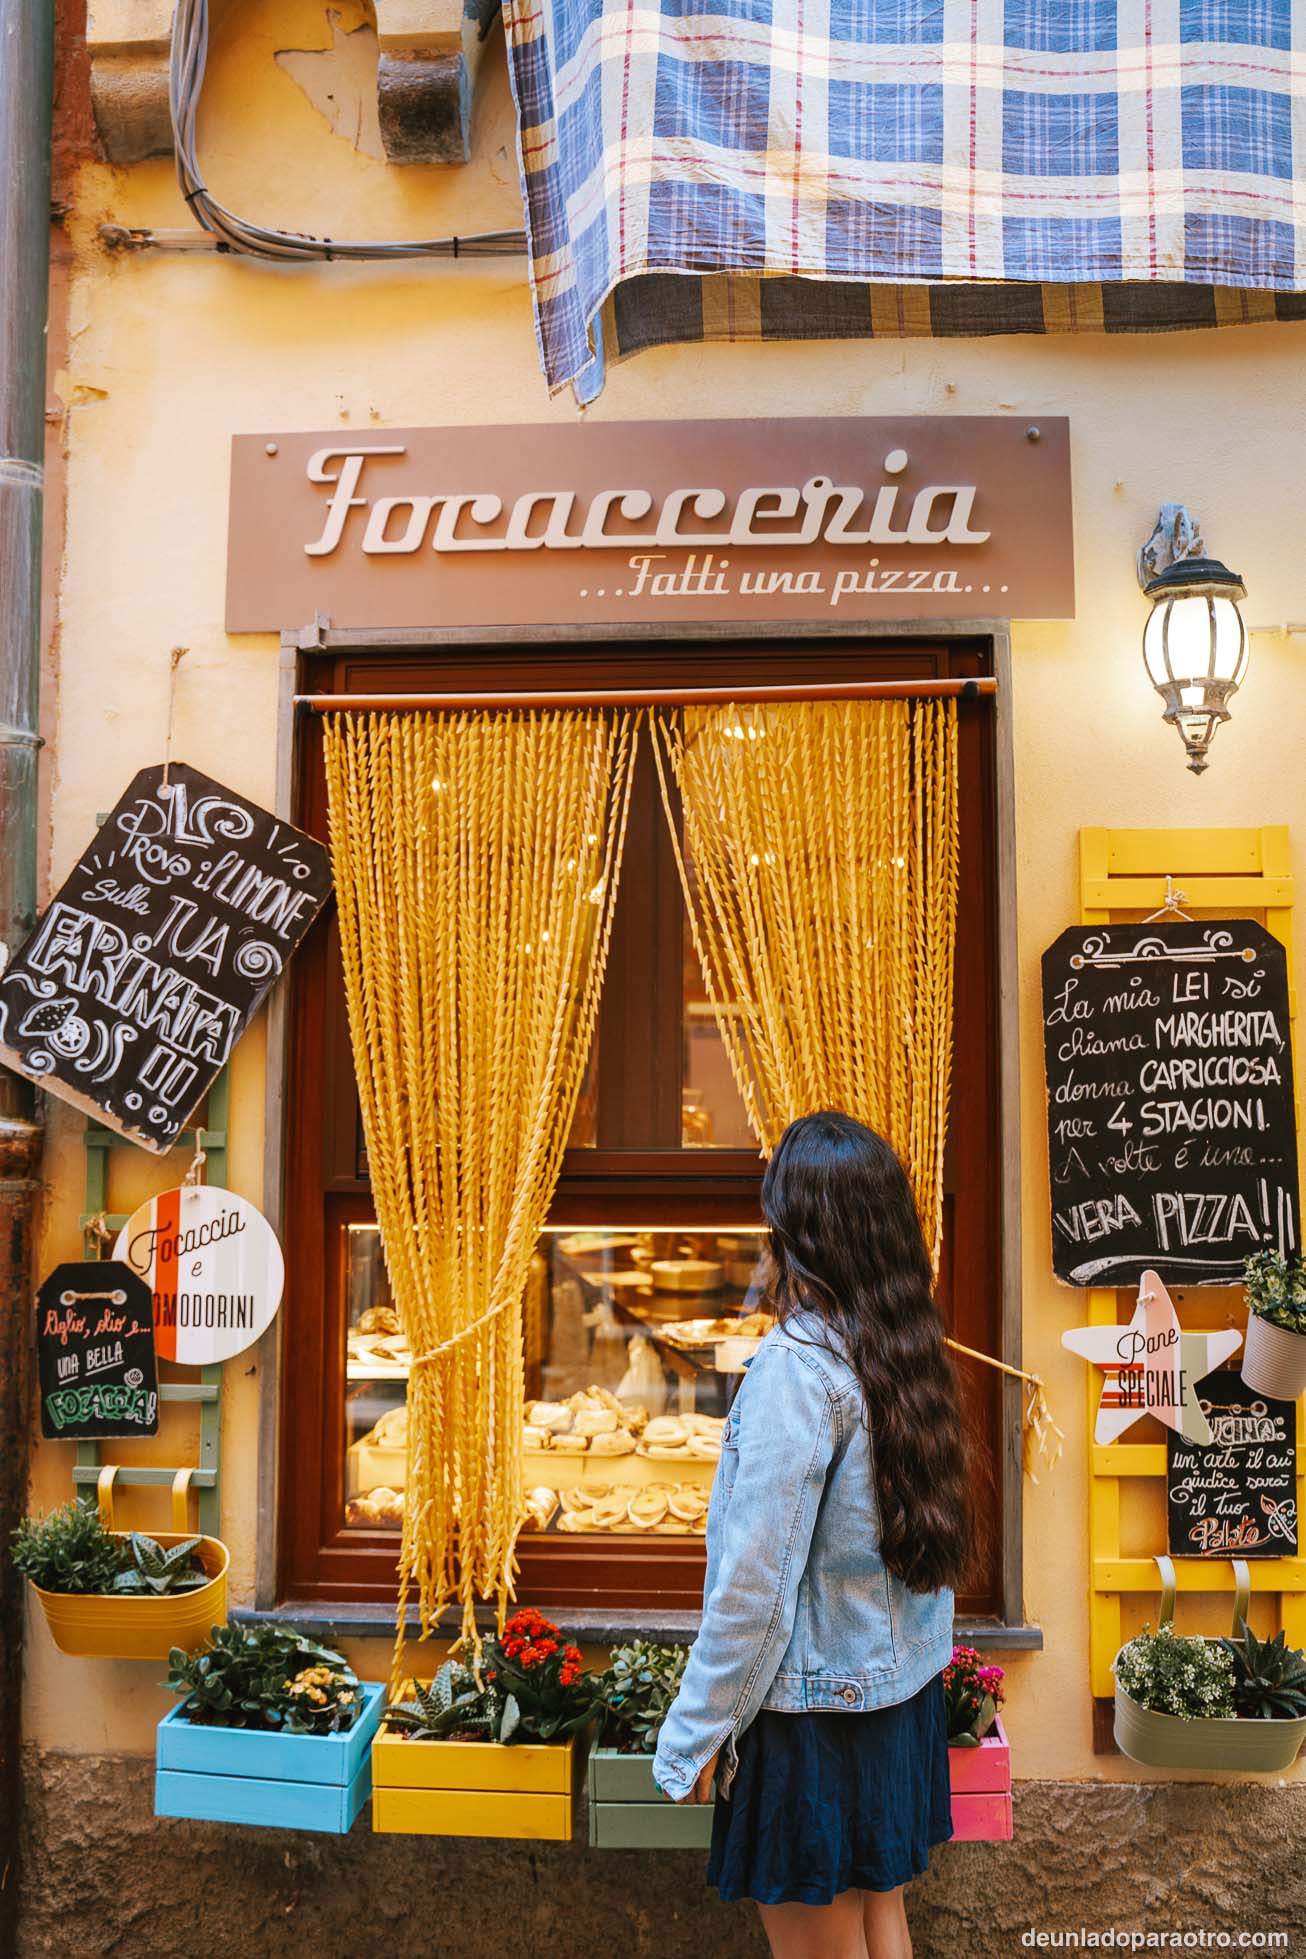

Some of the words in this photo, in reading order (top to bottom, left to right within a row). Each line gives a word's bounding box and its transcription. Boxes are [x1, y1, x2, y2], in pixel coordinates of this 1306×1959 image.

[304, 446, 991, 556] Focacceria
[580, 553, 730, 597] ...Fatti
[738, 570, 824, 596] una
[830, 558, 1009, 606] pizza...
[192, 850, 239, 891] il
[213, 859, 317, 939] LIMONE
[153, 895, 230, 976] TUA
[27, 902, 241, 1066] FARINATA
[1047, 978, 1095, 1025] La
[1103, 976, 1160, 1013] mia
[1173, 972, 1209, 1003] LEI
[1222, 970, 1266, 999] si
[1058, 1027, 1150, 1061] chiama
[1155, 1010, 1286, 1054] MARGHERITA,
[1055, 1068, 1135, 1103] donna
[1139, 1055, 1281, 1093] CAPRICCIOSA
[1054, 1117, 1098, 1145] per
[1106, 1101, 1133, 1137] 4
[1054, 1146, 1091, 1183] A
[1098, 1140, 1163, 1176] volte
[1053, 1194, 1143, 1243] VERA
[128, 1209, 246, 1276] Focaccia
[191, 1260, 203, 1277] e
[93, 1308, 127, 1337] olio
[153, 1293, 254, 1329] OMODORINI
[86, 1341, 124, 1370] BELLA
[1116, 1328, 1179, 1368] Pane
[1118, 1369, 1188, 1408] SPECIALE
[1246, 1448, 1264, 1469] il
[1181, 1469, 1239, 1492] giudice
[1189, 1493, 1207, 1516] il
[1213, 1492, 1250, 1515] tuo
